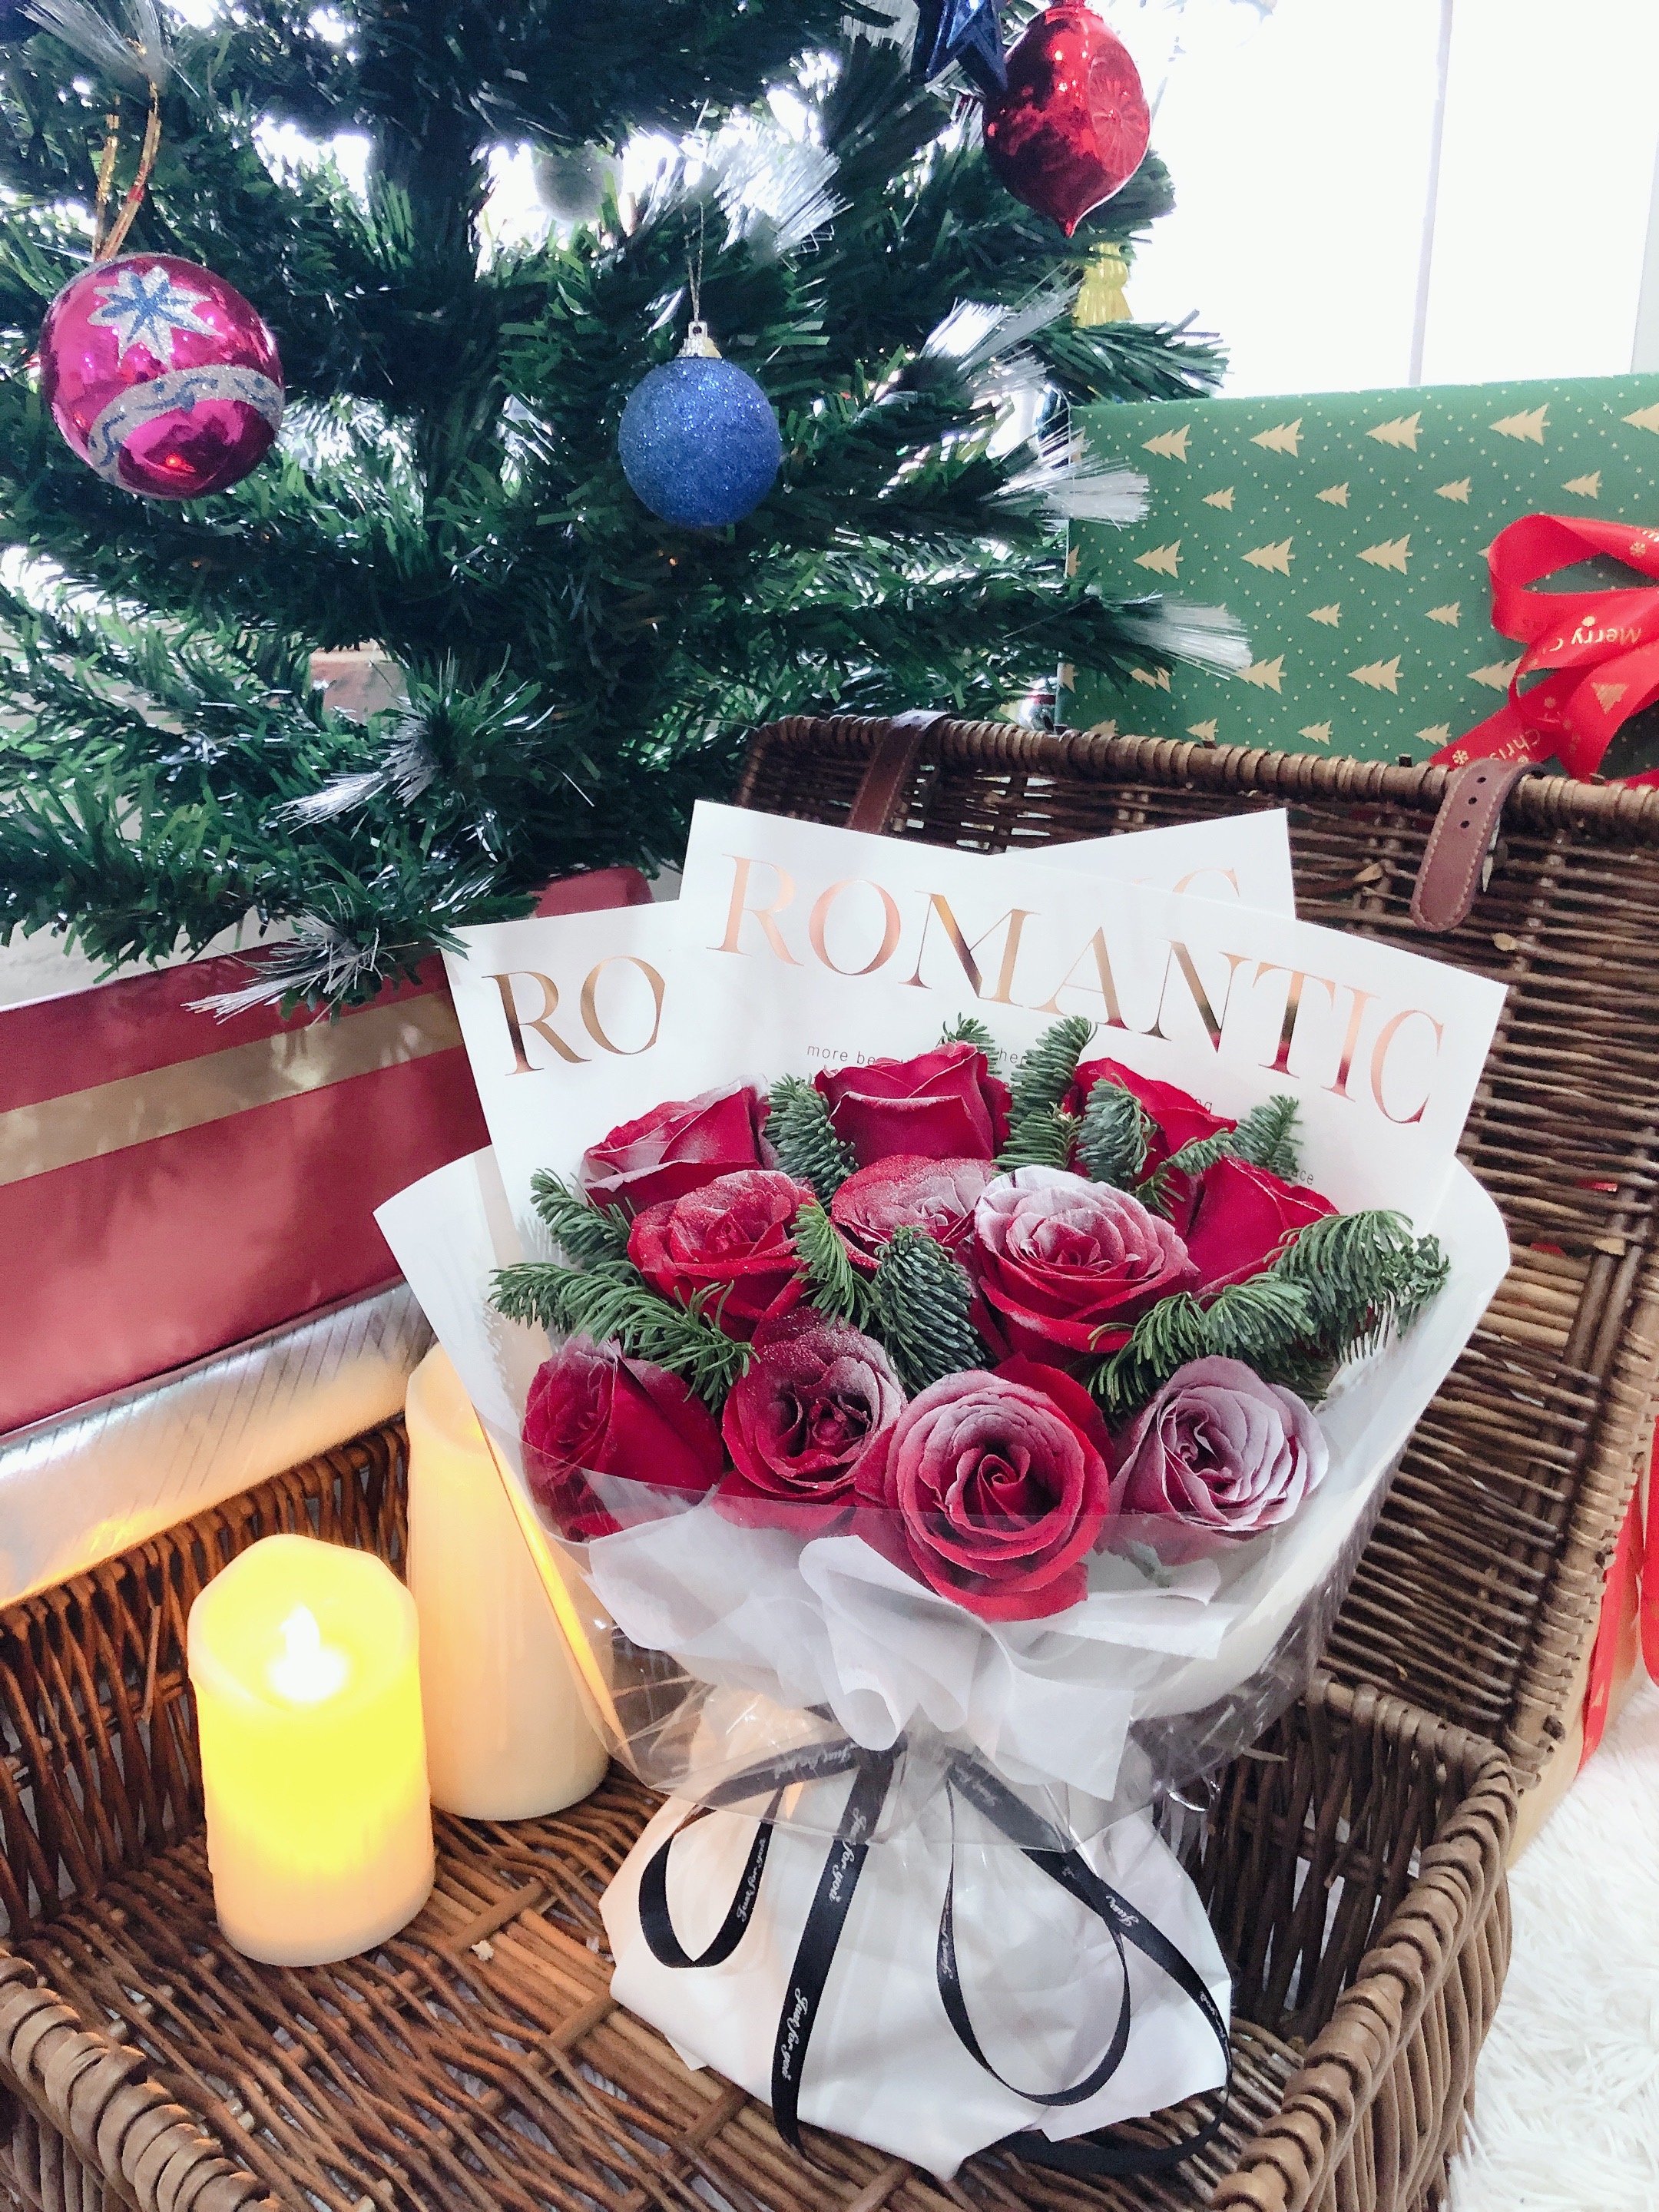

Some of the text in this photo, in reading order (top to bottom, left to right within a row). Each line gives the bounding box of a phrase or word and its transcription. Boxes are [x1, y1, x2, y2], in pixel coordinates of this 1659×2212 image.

[1571, 627, 1643, 646] Merry
[706, 853, 1444, 1124] ROMANTIC
[482, 955, 665, 1075] RO
[806, 1044, 848, 1061] more
[840, 1839, 856, 1869] for
[828, 1864, 843, 1902] you
[780, 1988, 808, 2081] Just for you
